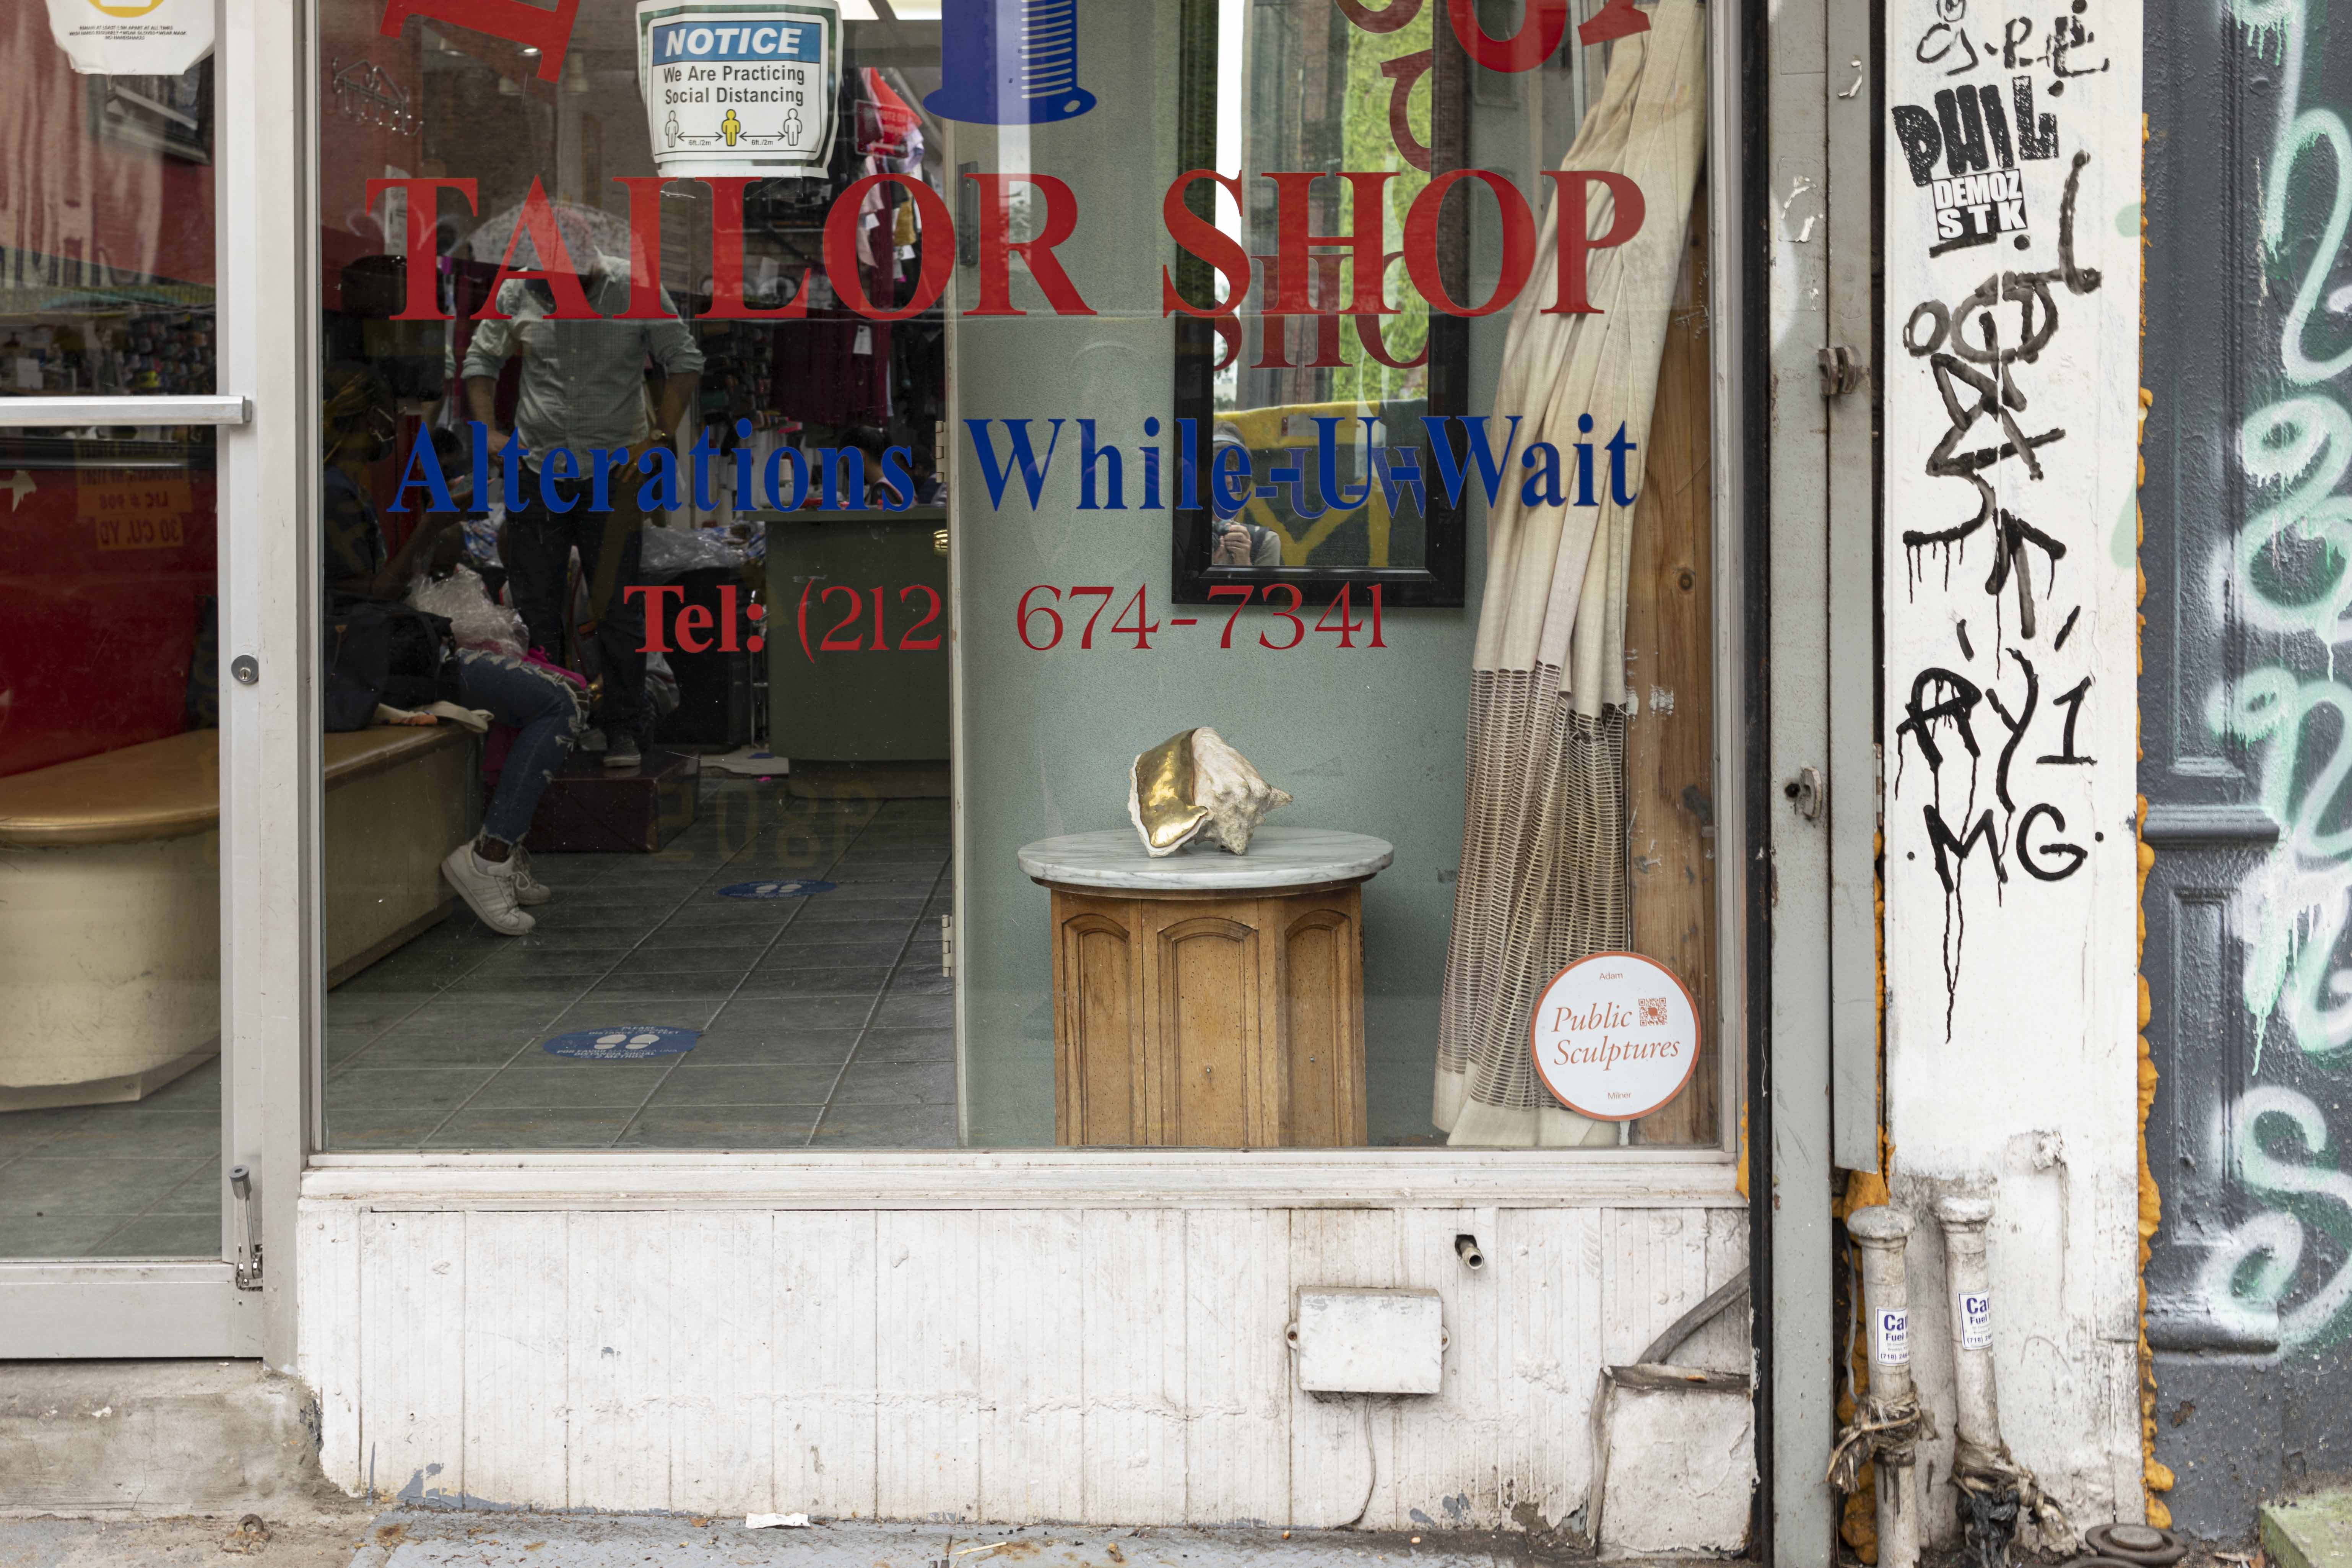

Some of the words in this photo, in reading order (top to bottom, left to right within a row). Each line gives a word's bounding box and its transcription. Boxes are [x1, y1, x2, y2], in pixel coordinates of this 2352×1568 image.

[665, 28, 803, 57] NOTICE
[663, 67, 682, 83] We
[688, 65, 717, 81] Are
[723, 65, 805, 85] Practicing
[665, 87, 710, 105] Social
[717, 87, 804, 107] Distancing
[1933, 170, 2023, 210] DEMOZ
[365, 173, 1098, 321] TAILOR
[1163, 169, 1646, 318] SHOP
[386, 418, 915, 513] Alterations
[963, 413, 1637, 512] While-U-Wait
[623, 585, 764, 653] Tel:
[798, 578, 942, 663] (212
[1016, 581, 1388, 651] 674-7341
[1551, 1002, 1633, 1033] Public
[1554, 1035, 1681, 1071] Sculptures
[1608, 1092, 1632, 1100] Milner
[1970, 1315, 1987, 1324] Fuel
[1886, 1332, 1904, 1341] Fuel
